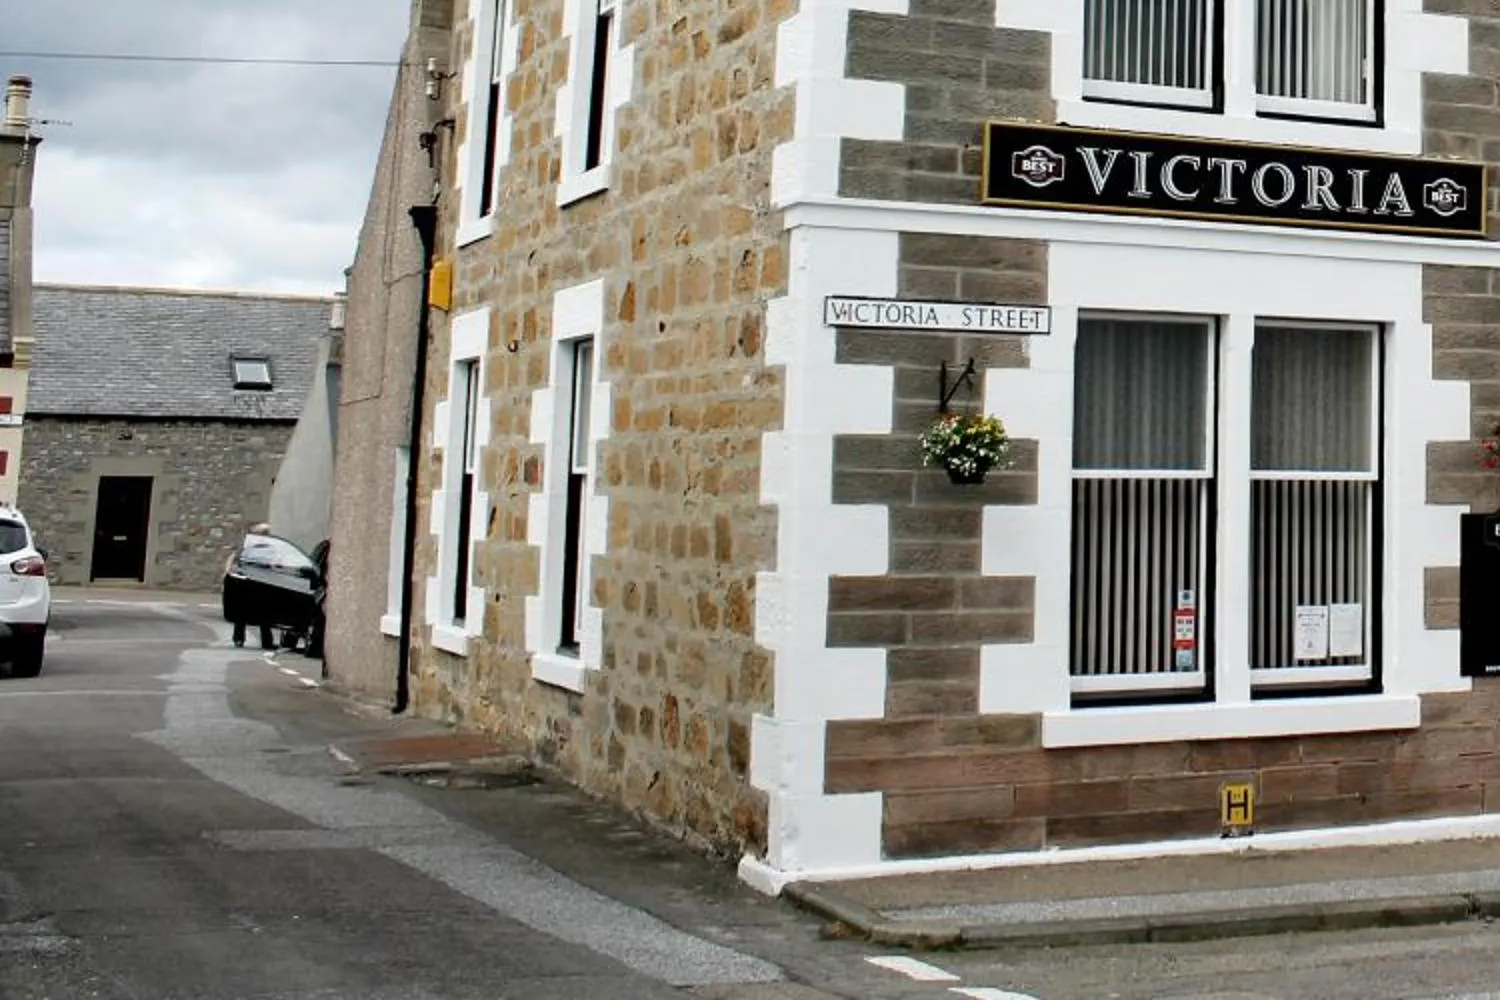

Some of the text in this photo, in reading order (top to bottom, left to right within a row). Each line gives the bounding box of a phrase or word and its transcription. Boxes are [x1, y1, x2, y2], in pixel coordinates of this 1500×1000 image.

[1021, 159, 1056, 173] BEST
[1076, 146, 1415, 217] VICTORIA
[831, 302, 1045, 329] VICTORIA STREET
[1227, 788, 1248, 821] H
